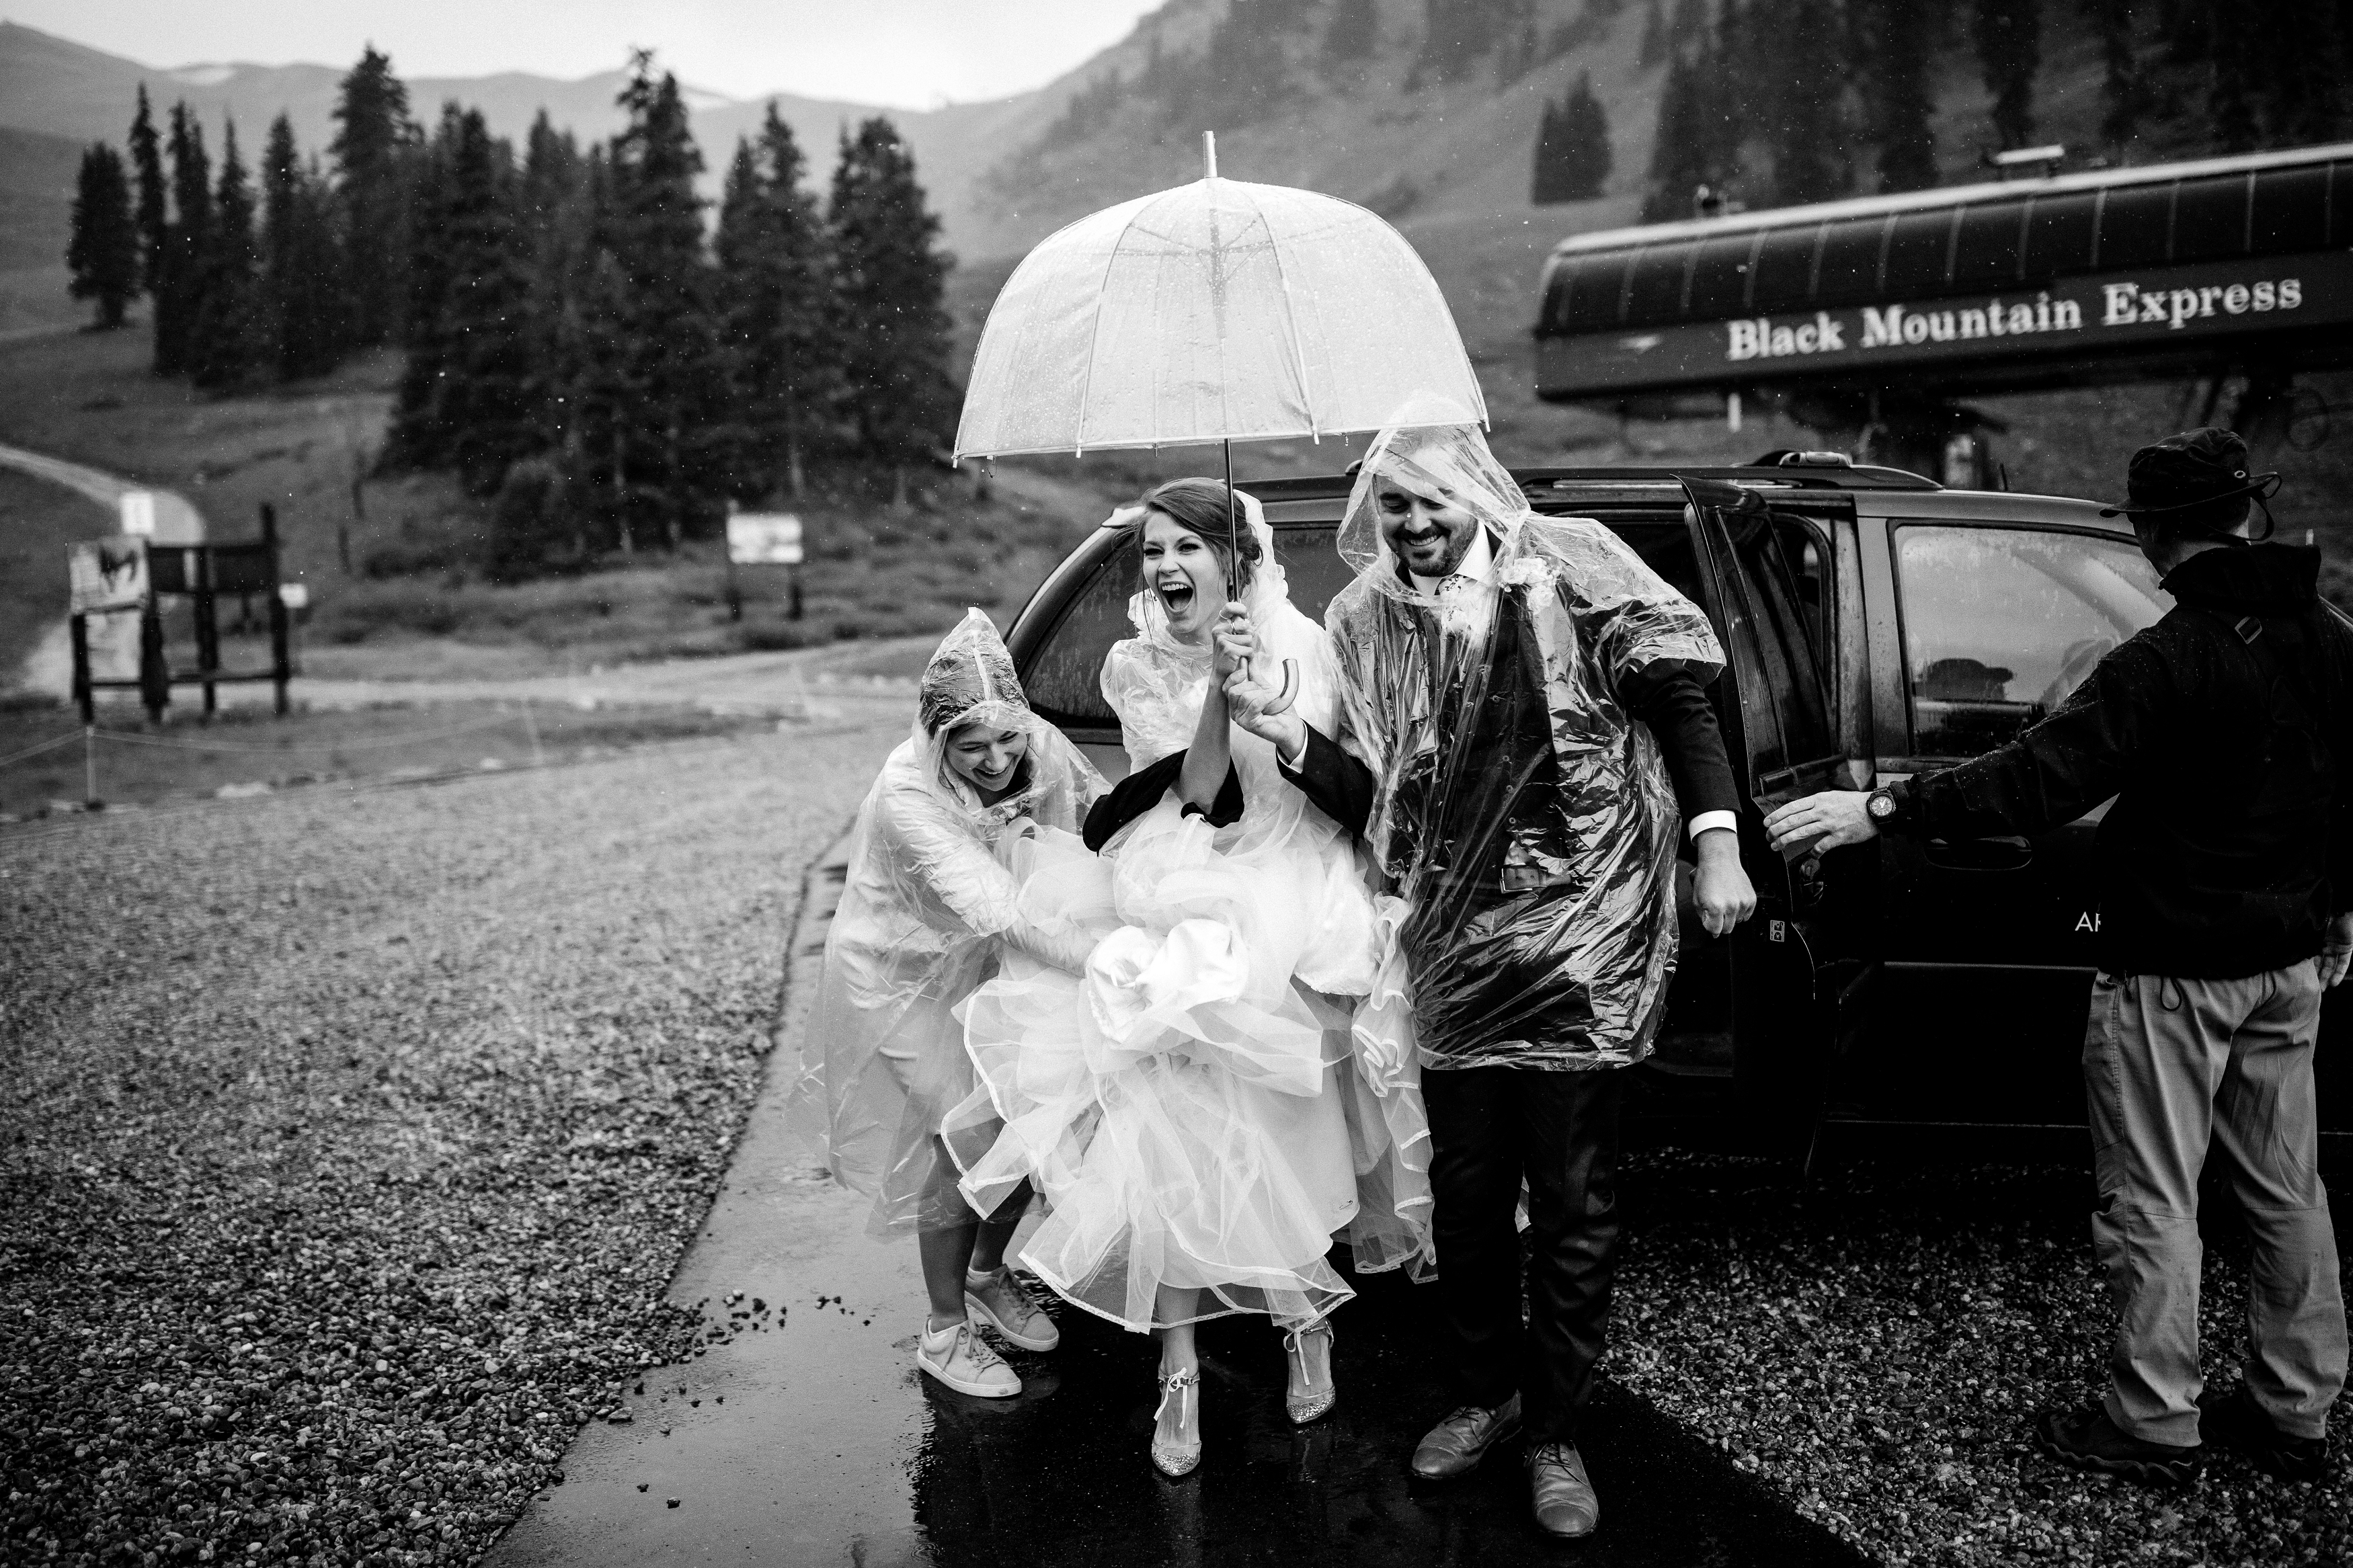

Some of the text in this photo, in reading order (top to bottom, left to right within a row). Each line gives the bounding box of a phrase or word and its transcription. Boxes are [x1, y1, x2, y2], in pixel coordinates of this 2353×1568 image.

[1726, 279, 2302, 360] Black Mountain Express
